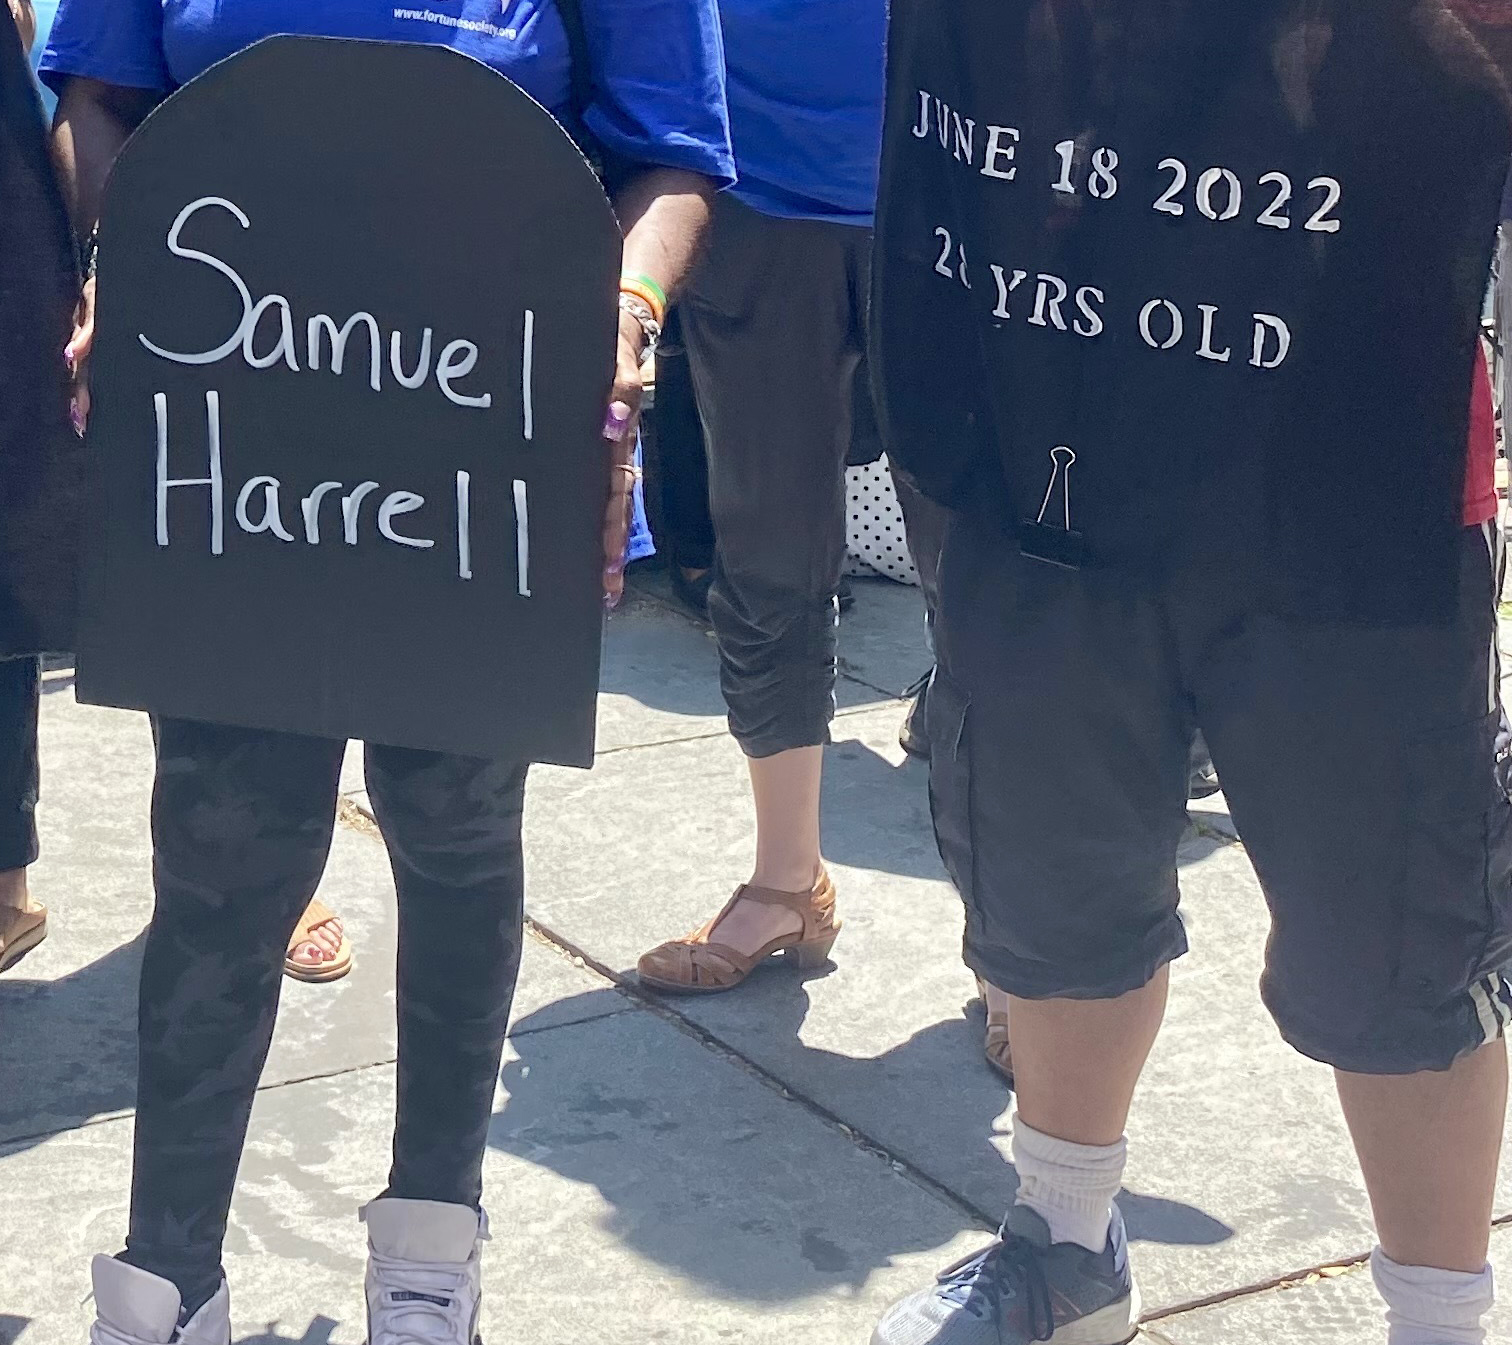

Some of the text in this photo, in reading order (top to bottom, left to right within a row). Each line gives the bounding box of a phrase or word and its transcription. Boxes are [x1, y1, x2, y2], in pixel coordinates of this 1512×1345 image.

[912, 90, 1342, 233] JUNE 18 2022
[138, 195, 535, 440] Samuel
[990, 264, 1291, 369] YRS OLD
[154, 390, 531, 597] Harrell
